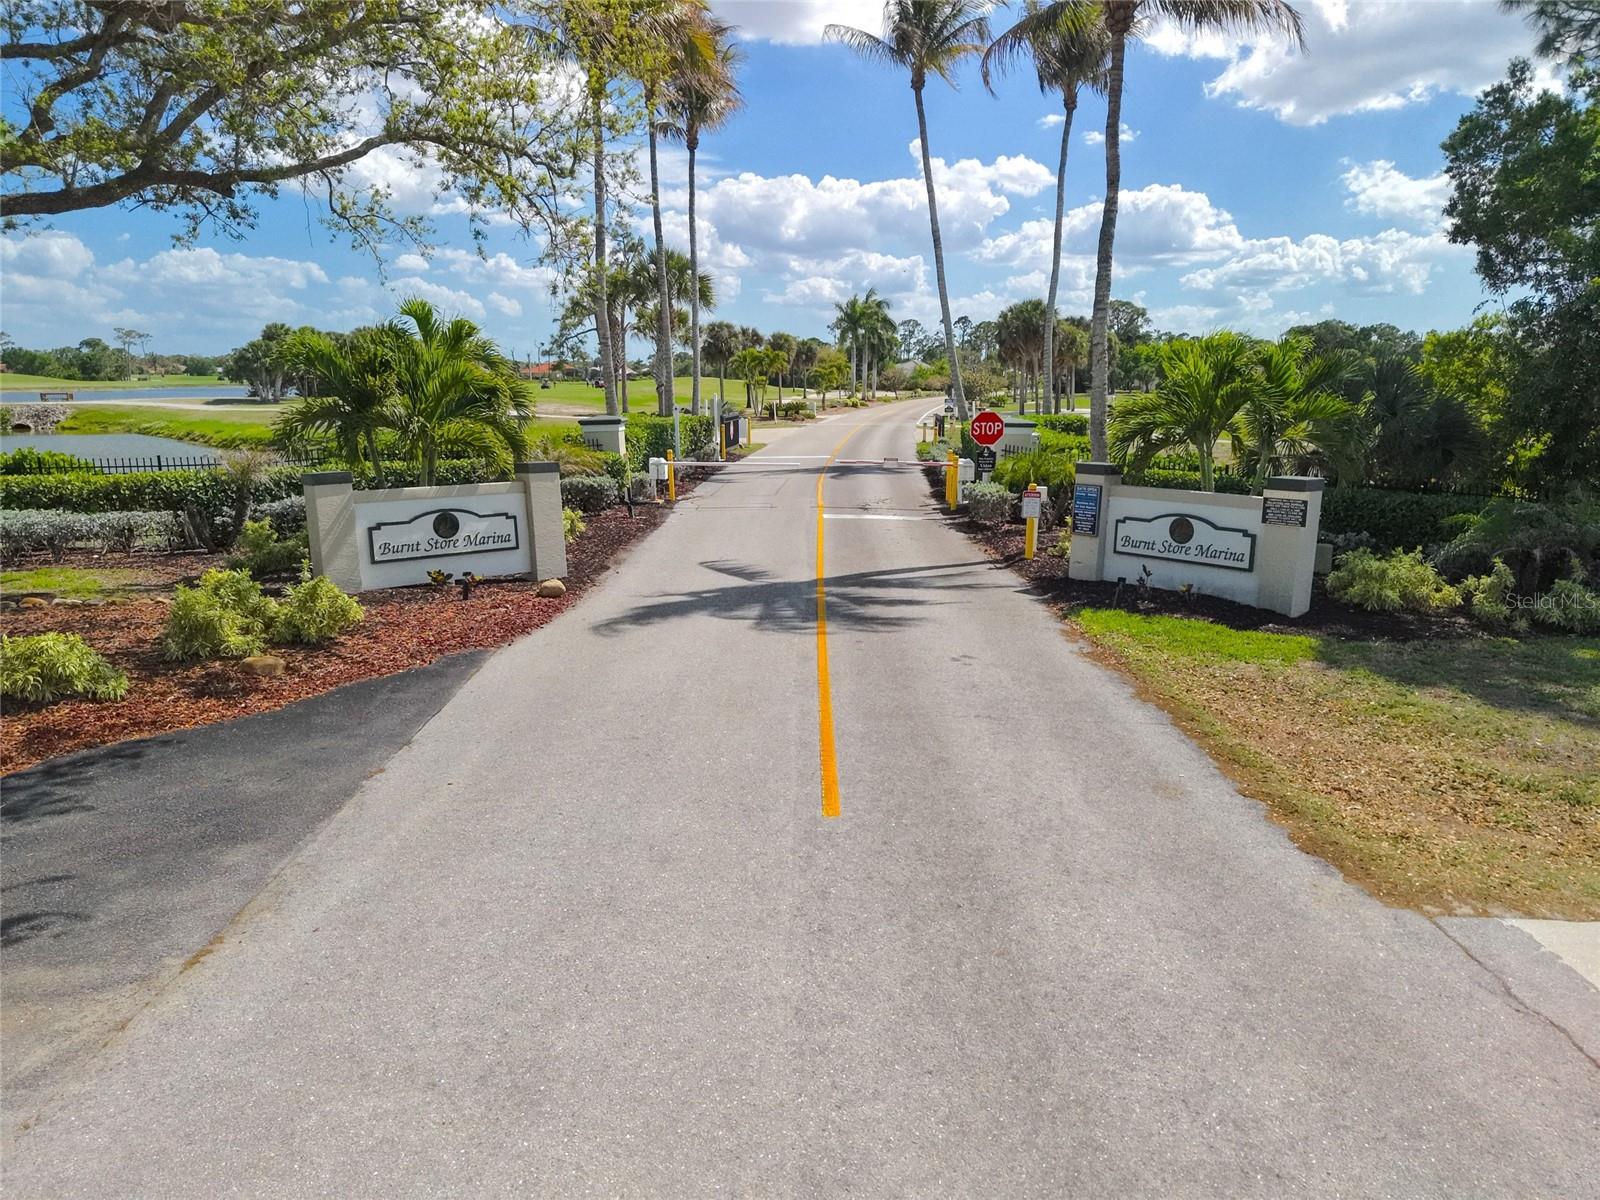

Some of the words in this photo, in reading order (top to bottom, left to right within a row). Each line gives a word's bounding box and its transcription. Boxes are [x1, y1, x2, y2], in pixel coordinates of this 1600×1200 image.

[972, 422, 1002, 435] STOP
[379, 541, 421, 555] Burnt
[424, 538, 459, 553] Store
[463, 531, 512, 547] Marina
[1121, 535, 1156, 551] Burnt
[1158, 540, 1192, 556] Store
[1194, 544, 1245, 562] Marina
